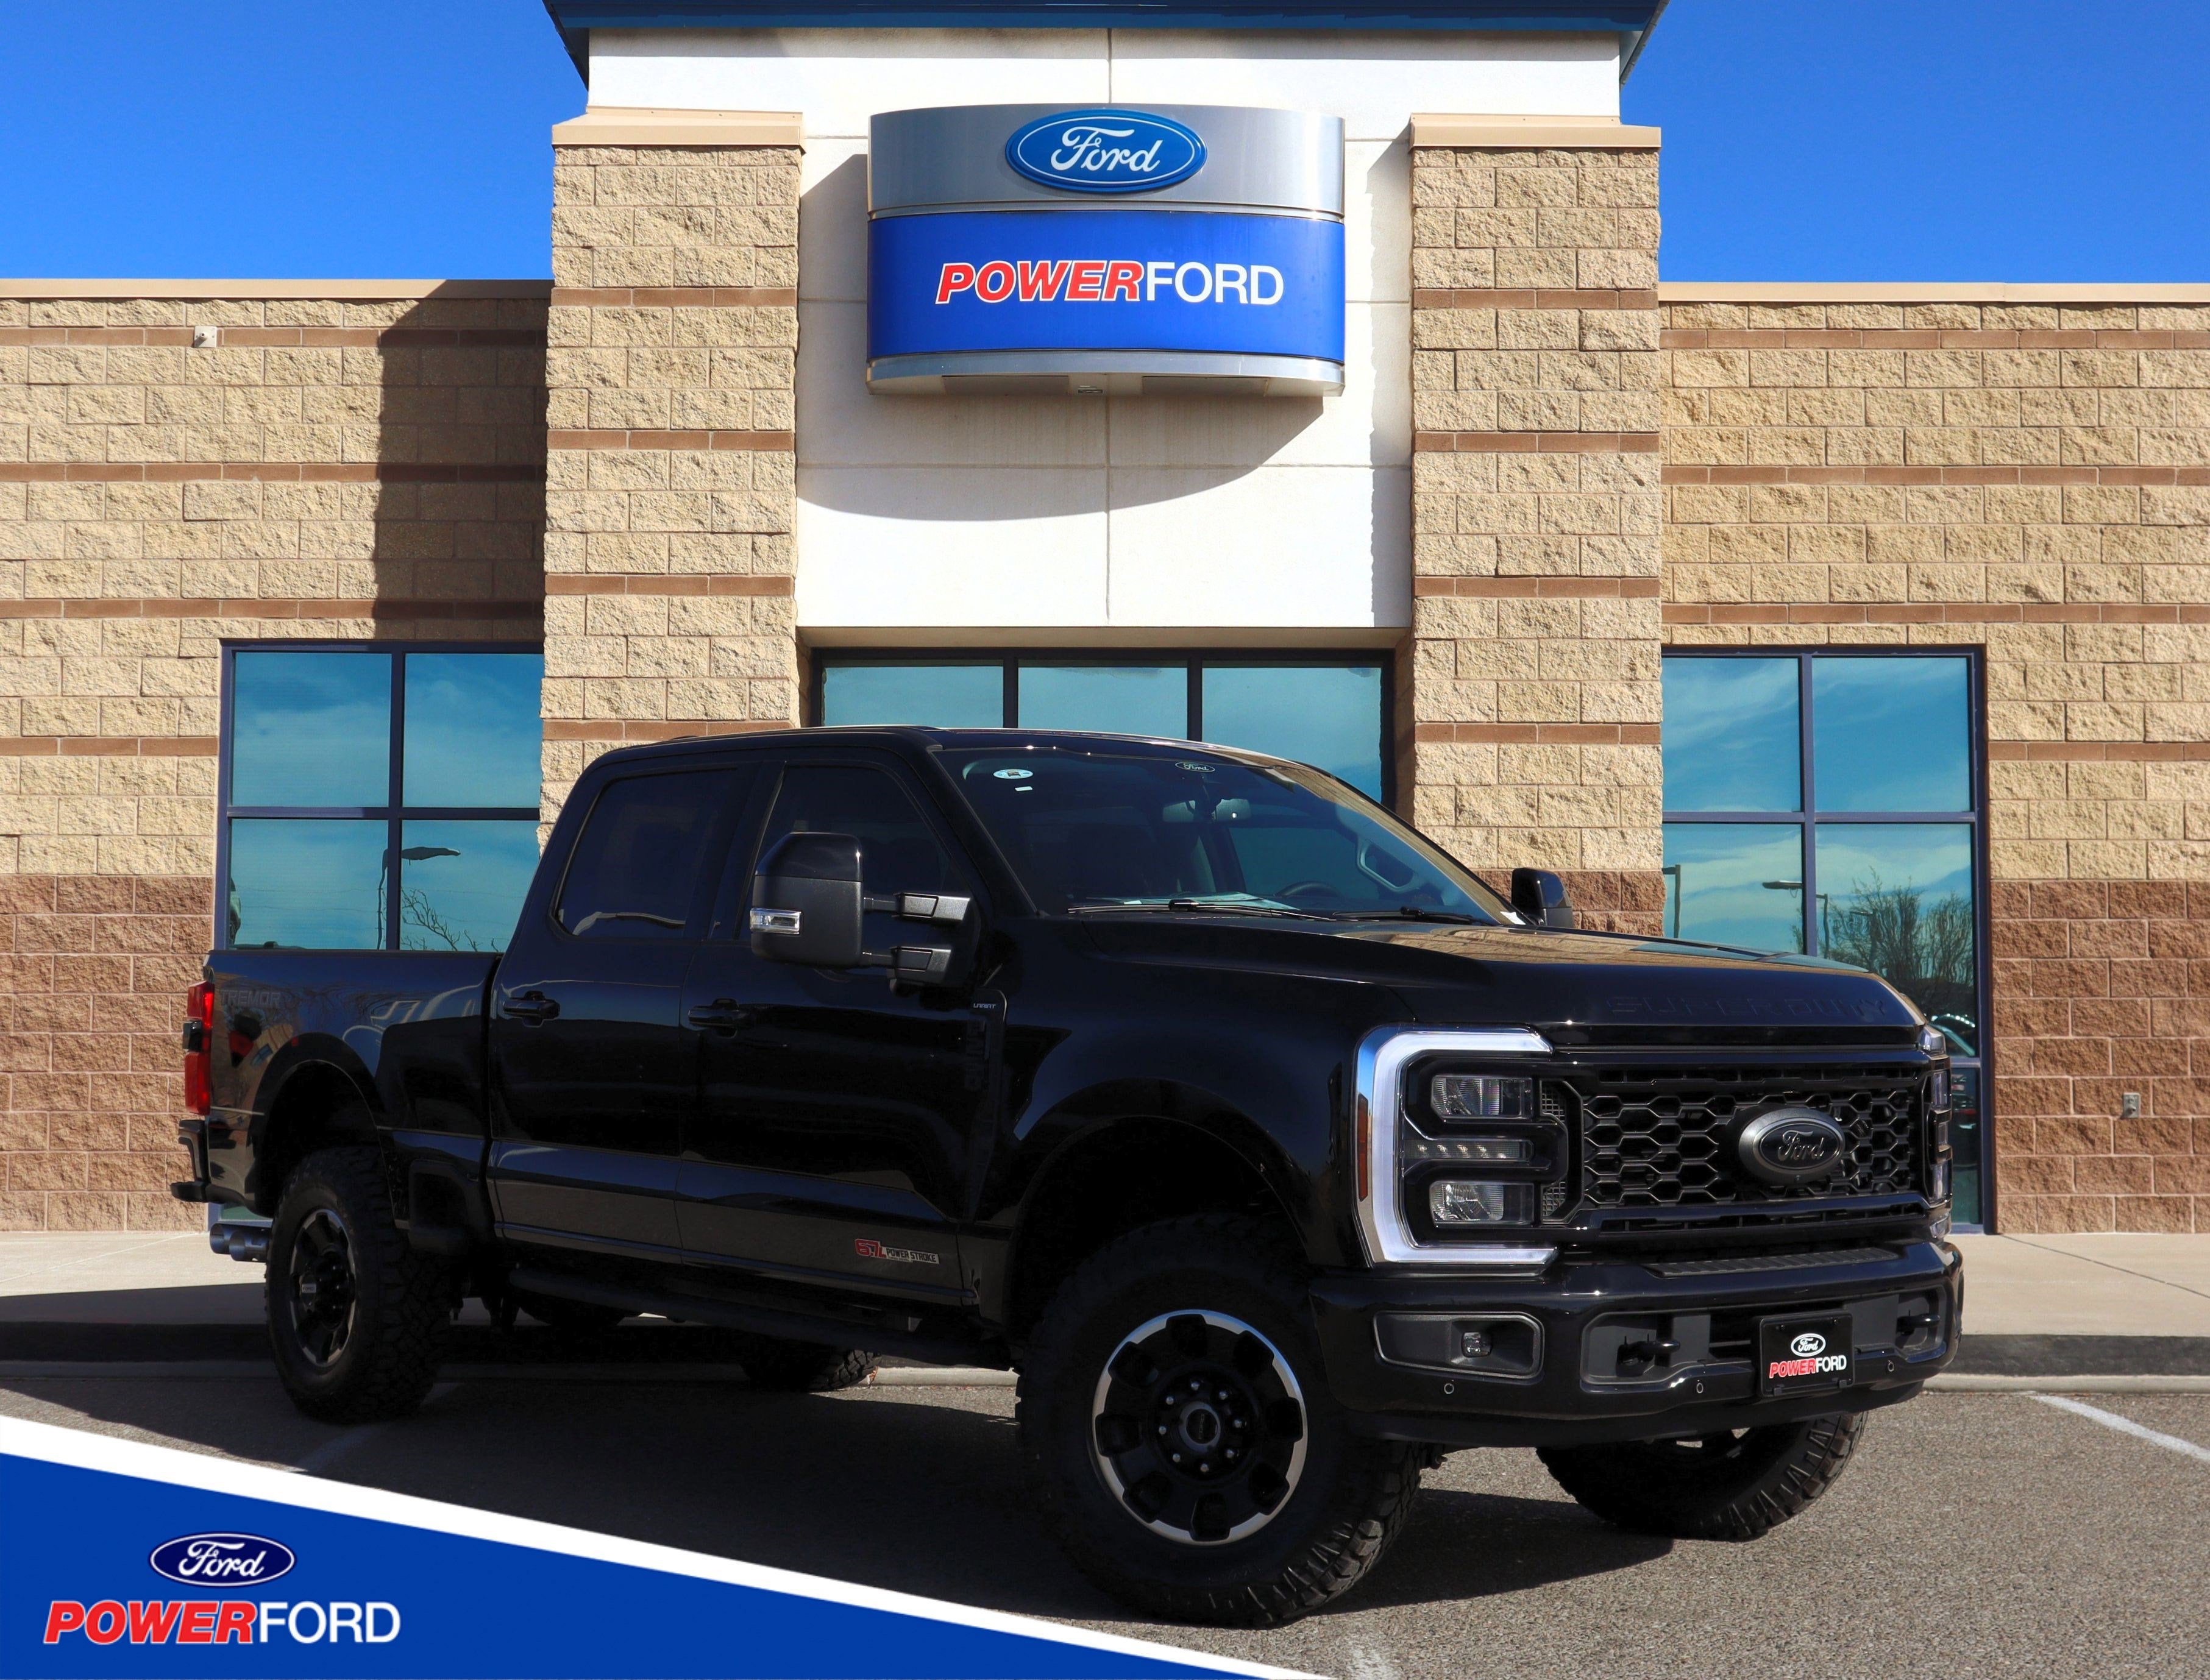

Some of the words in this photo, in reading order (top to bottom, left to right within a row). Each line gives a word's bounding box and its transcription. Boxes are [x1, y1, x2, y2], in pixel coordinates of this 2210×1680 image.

[1050, 126, 1163, 172] Ford
[221, 990, 280, 1006] TREMOR
[1778, 1130, 1825, 1161] Ford
[886, 1247, 910, 1259] POWER
[910, 1252, 937, 1263] STROKE
[1798, 1338, 1819, 1352] Ford
